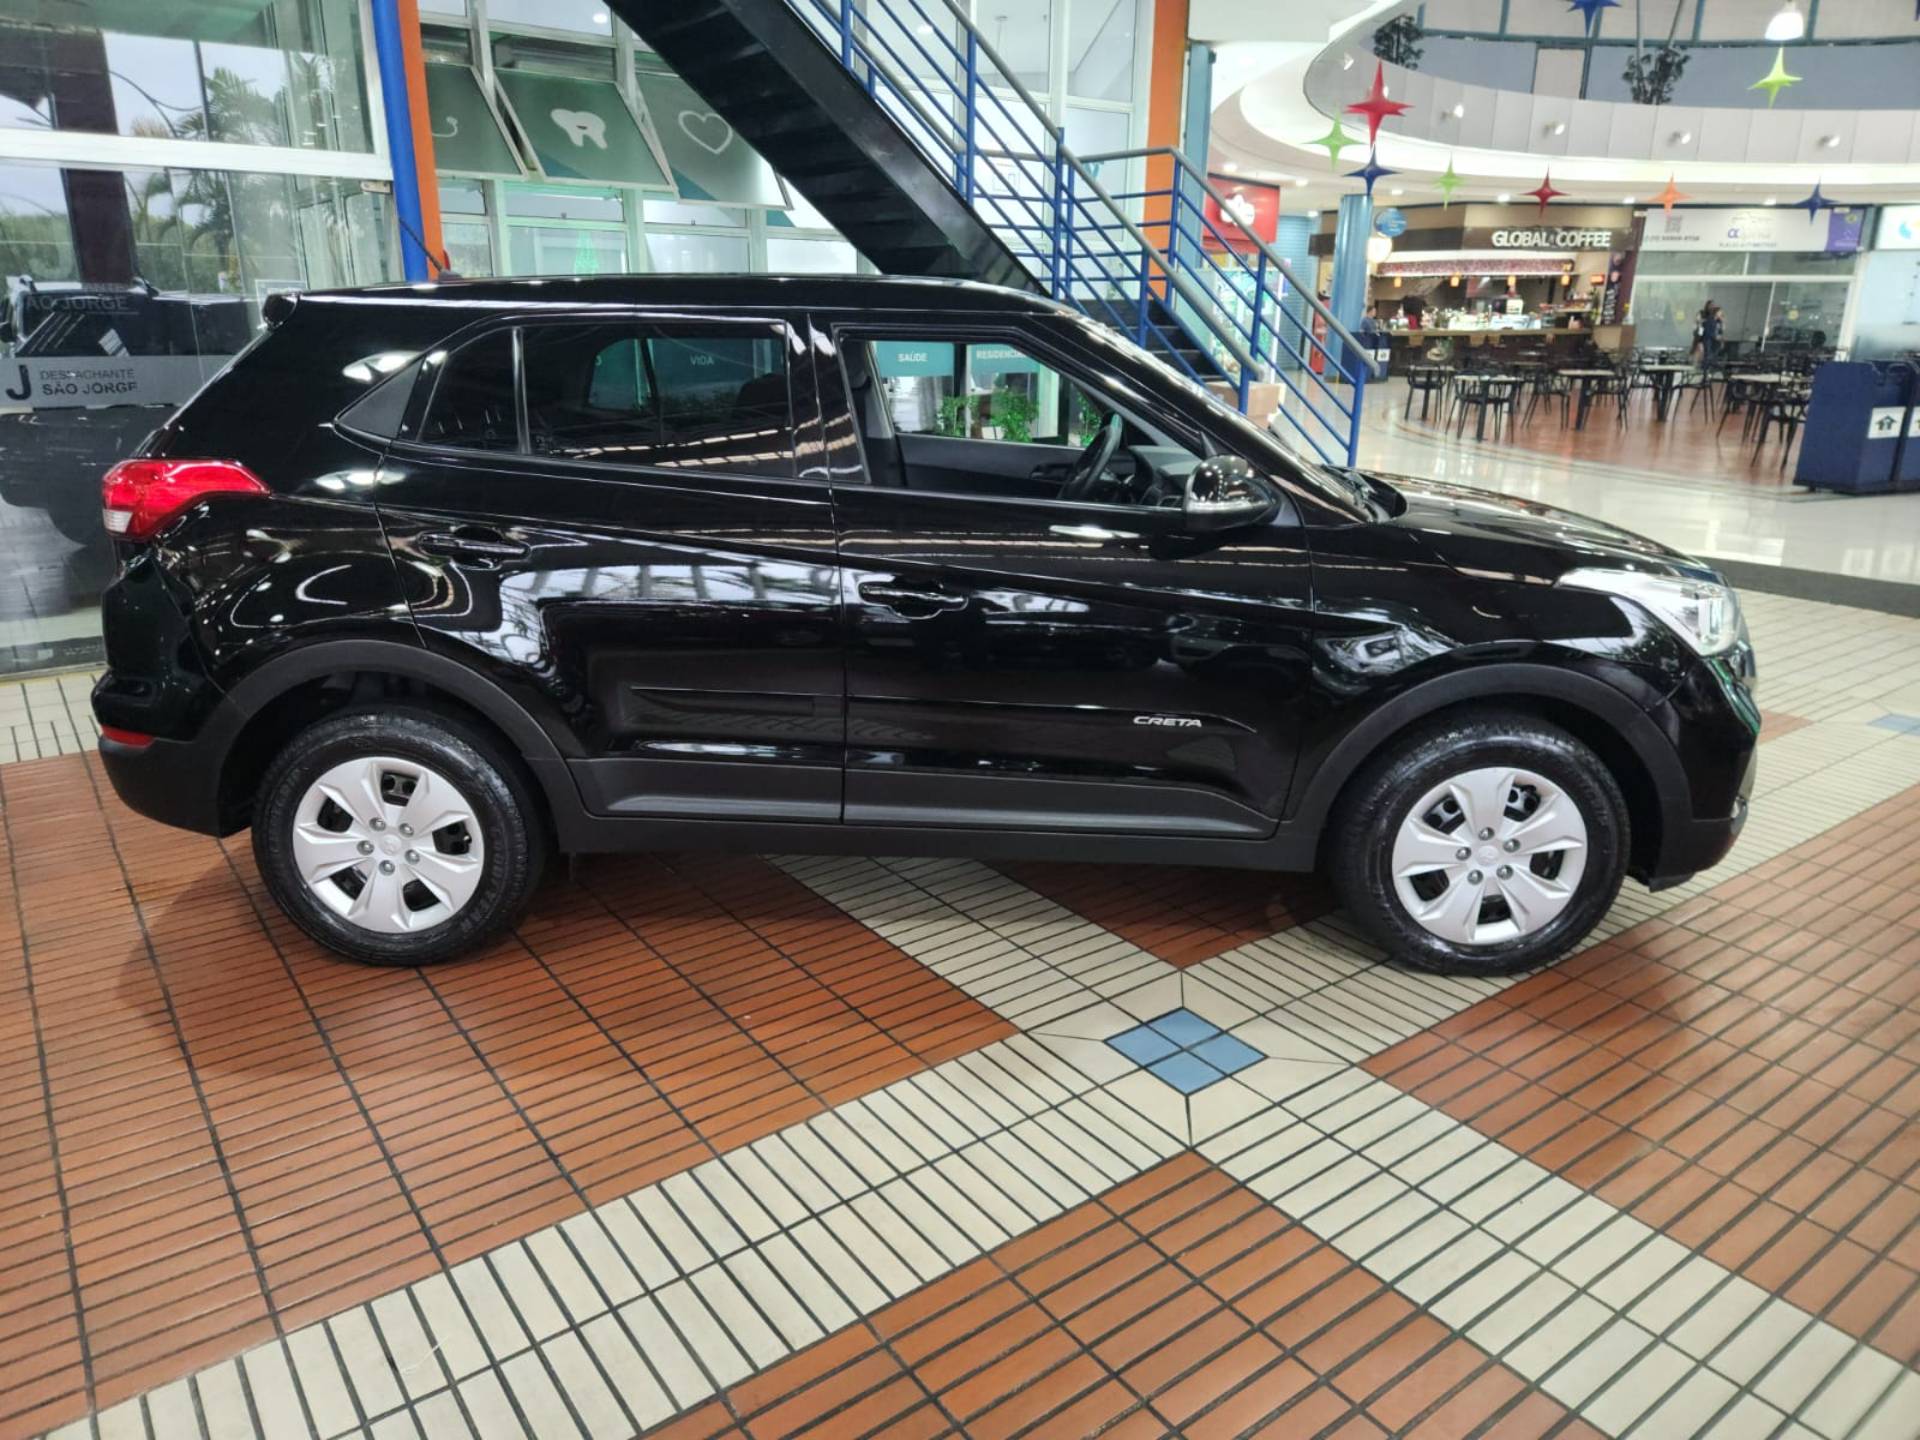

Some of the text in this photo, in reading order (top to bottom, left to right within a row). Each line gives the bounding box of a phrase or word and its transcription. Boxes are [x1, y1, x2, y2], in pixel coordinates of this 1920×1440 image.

[1492, 230, 1612, 247] GLOBAL COFFEE
[690, 354, 714, 366] VIDA
[897, 350, 929, 362] SAÚDE
[1133, 715, 1202, 728] CRETA
